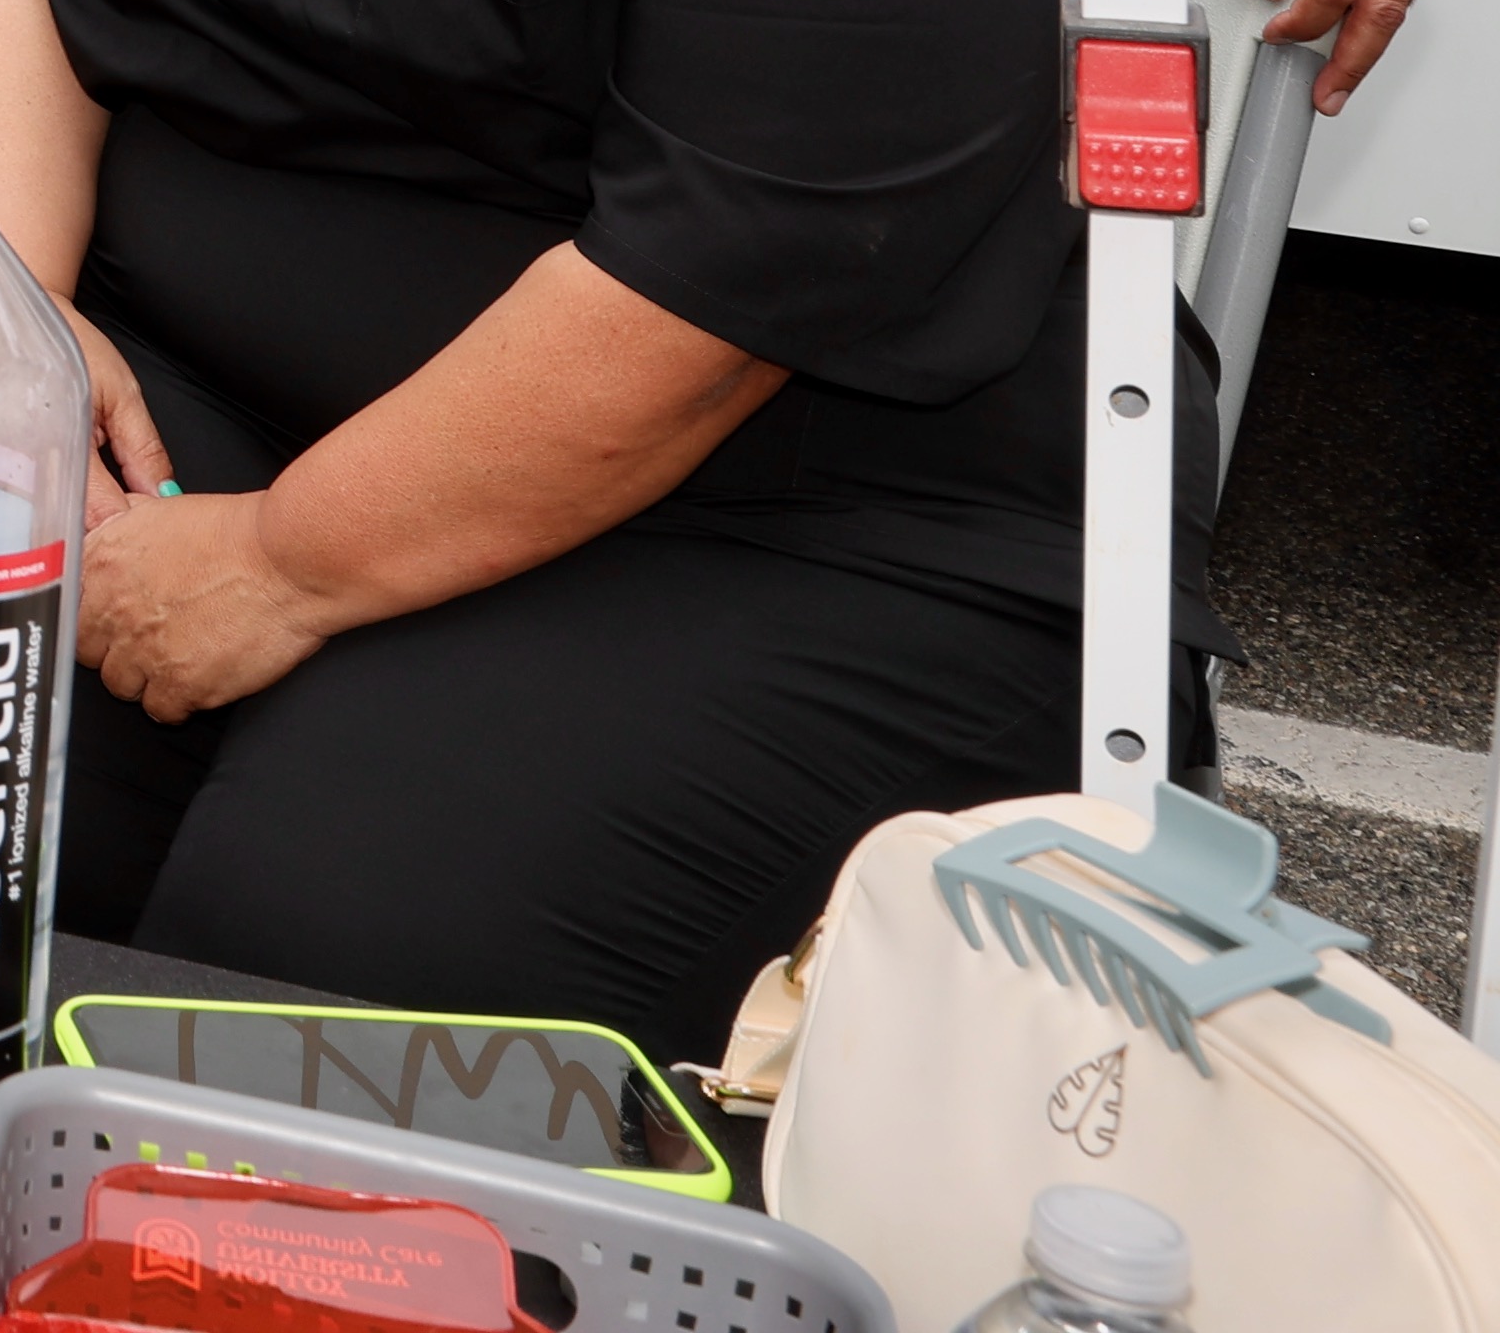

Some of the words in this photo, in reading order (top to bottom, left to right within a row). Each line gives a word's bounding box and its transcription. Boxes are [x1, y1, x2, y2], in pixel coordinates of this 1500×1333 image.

[25, 623, 43, 688] water
[15, 693, 37, 777] alkaline
[9, 783, 29, 865] ionized
[7, 870, 22, 902] #1
